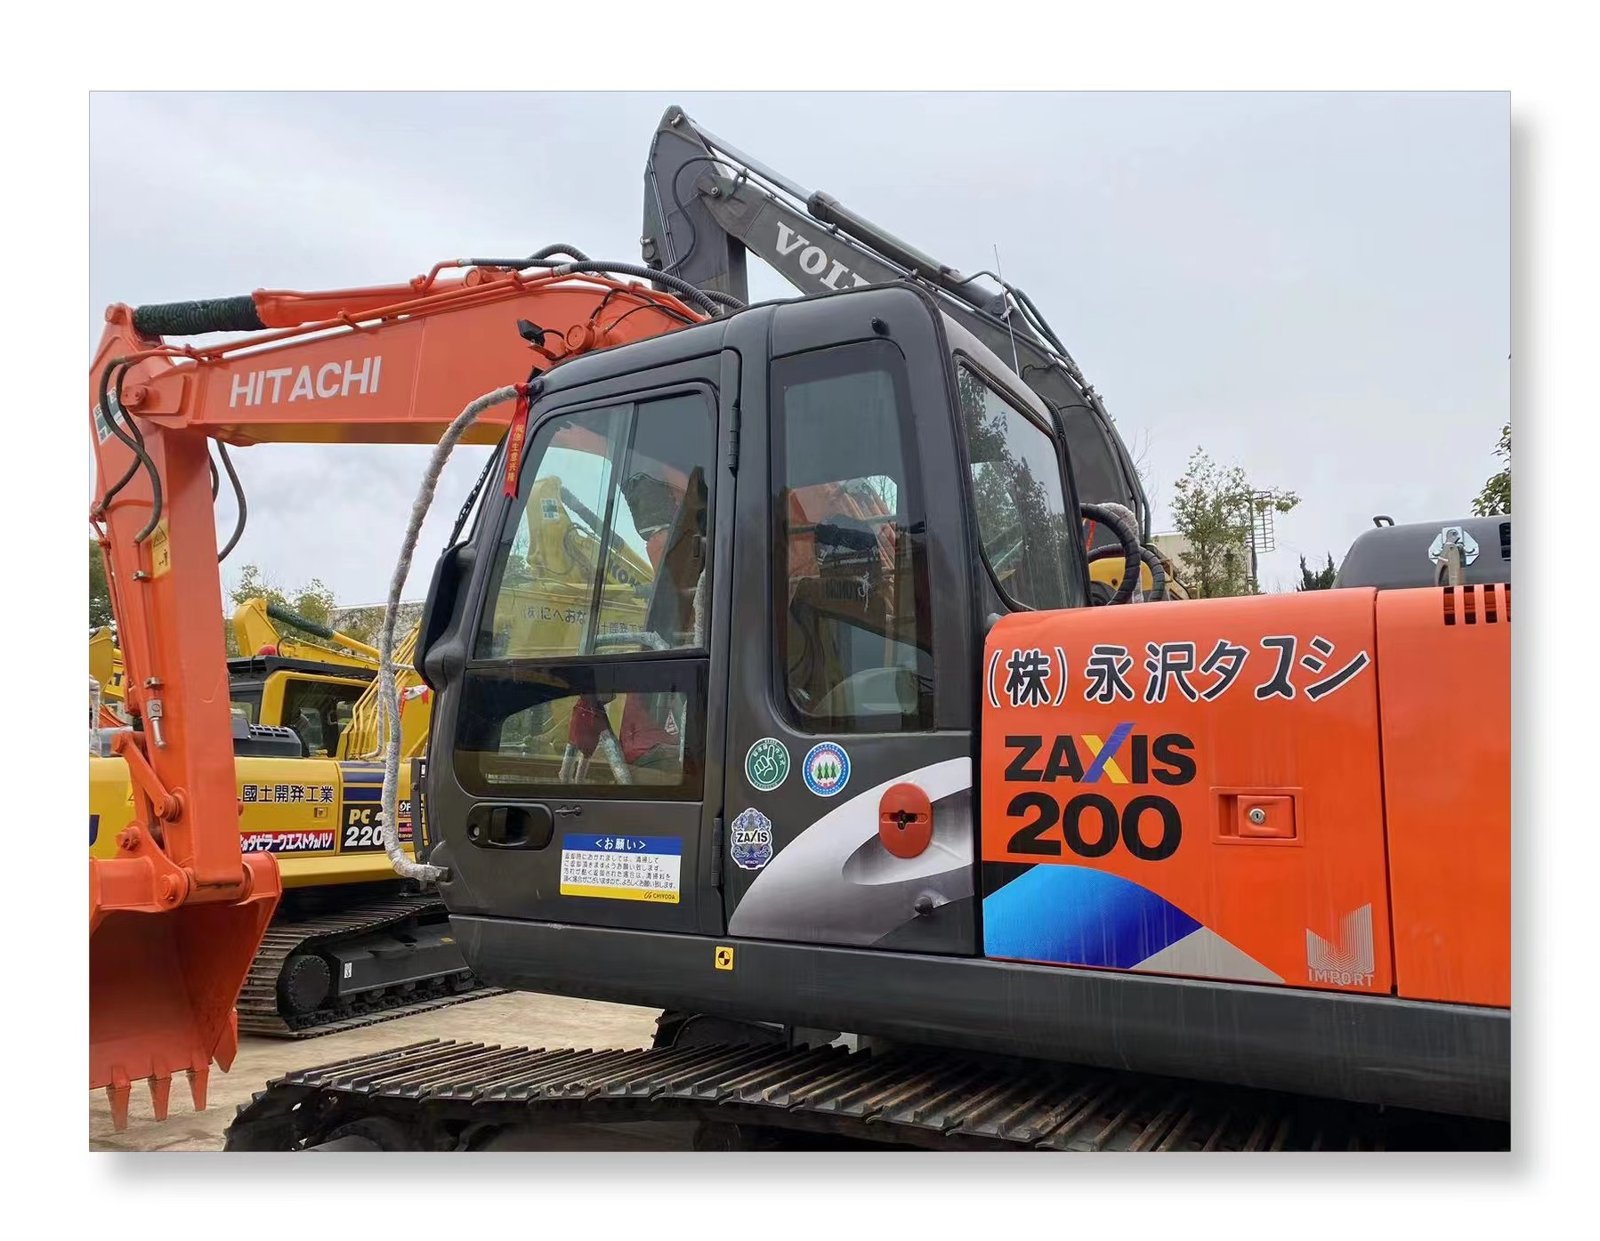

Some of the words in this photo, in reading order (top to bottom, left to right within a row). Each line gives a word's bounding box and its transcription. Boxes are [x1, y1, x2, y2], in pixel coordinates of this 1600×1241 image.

[229, 356, 382, 408] HITACHI
[1004, 722, 1198, 785] ZAXIS
[349, 809, 371, 825] PC
[1006, 791, 1182, 862] 200
[1308, 968, 1374, 987] IMPORT
